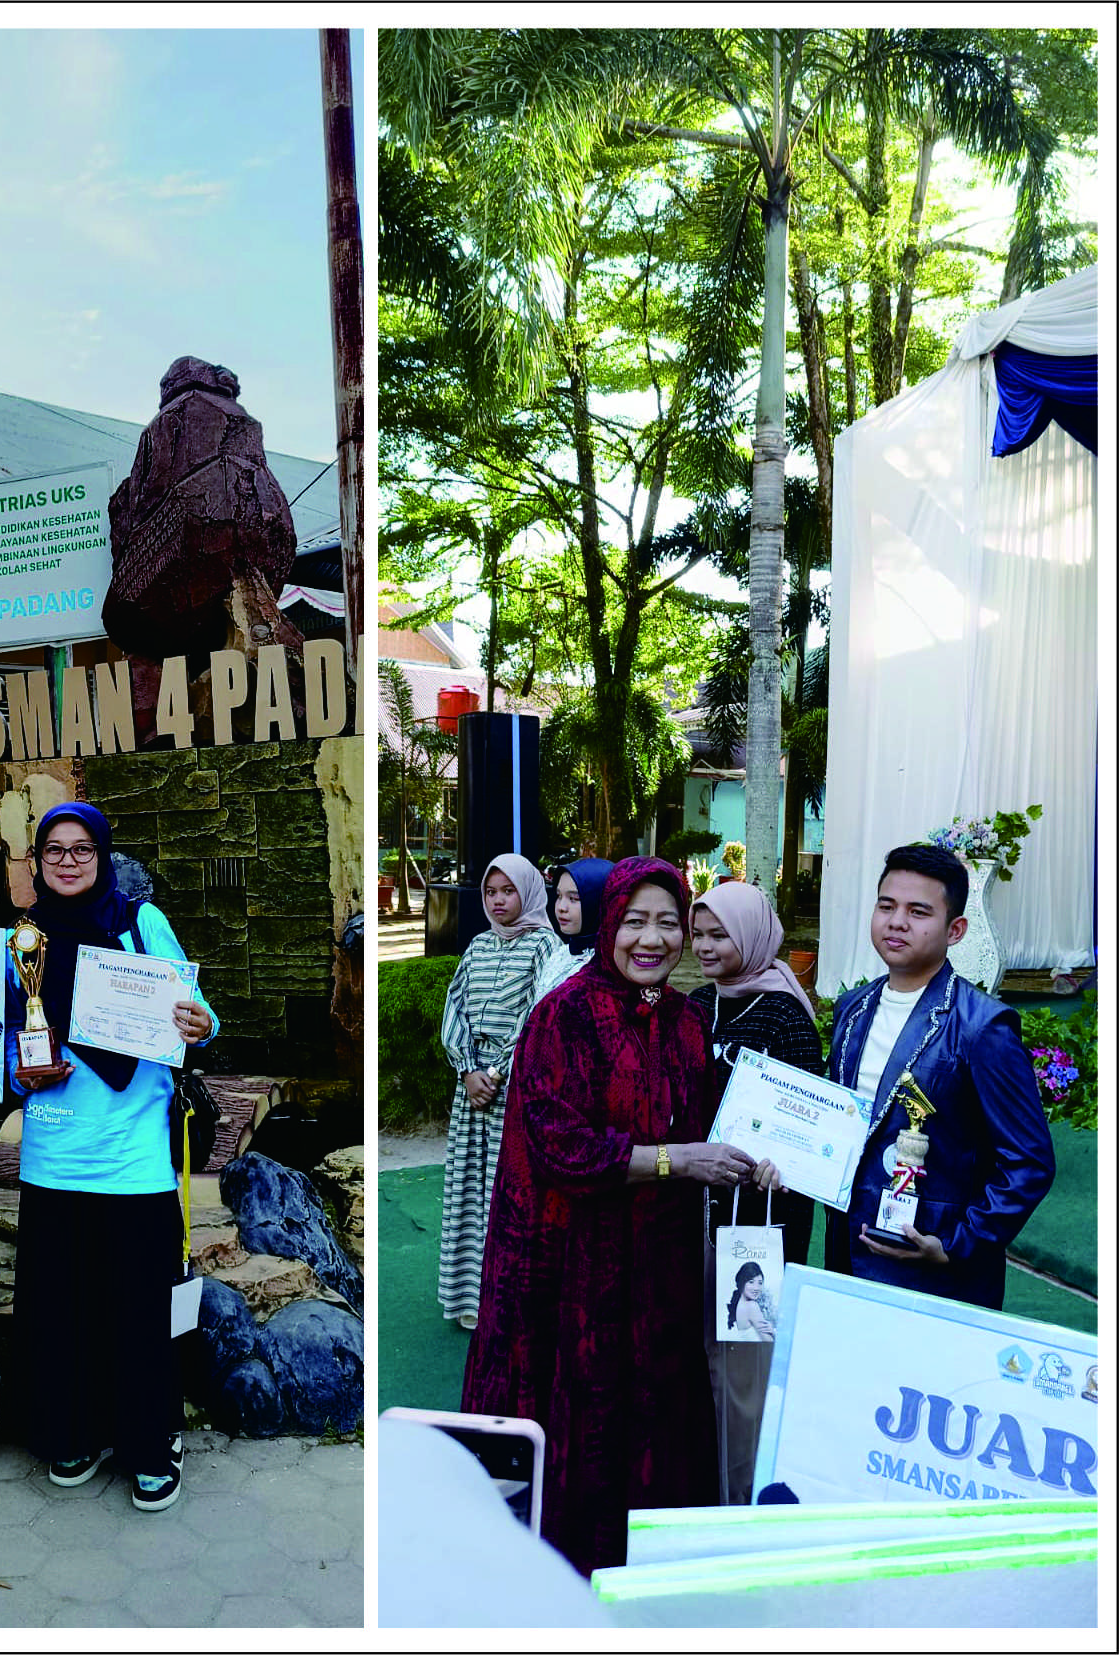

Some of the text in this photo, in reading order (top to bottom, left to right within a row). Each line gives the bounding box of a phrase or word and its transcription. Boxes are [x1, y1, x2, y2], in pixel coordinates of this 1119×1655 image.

[51, 485, 86, 504] UKS
[42, 509, 101, 528] KESEHATAN
[42, 524, 99, 541] KESEHATAN
[42, 537, 107, 556] LINGKUNGAN
[30, 558, 62, 572] SEHAT
[155, 655, 195, 750] 4
[210, 635, 364, 746] PAD
[760, 1072, 790, 1090] PIAGAM
[790, 1084, 845, 1111] PENGHARGAAN
[778, 1097, 811, 1118] JUARA
[875, 1386, 1098, 1498] JUAR
